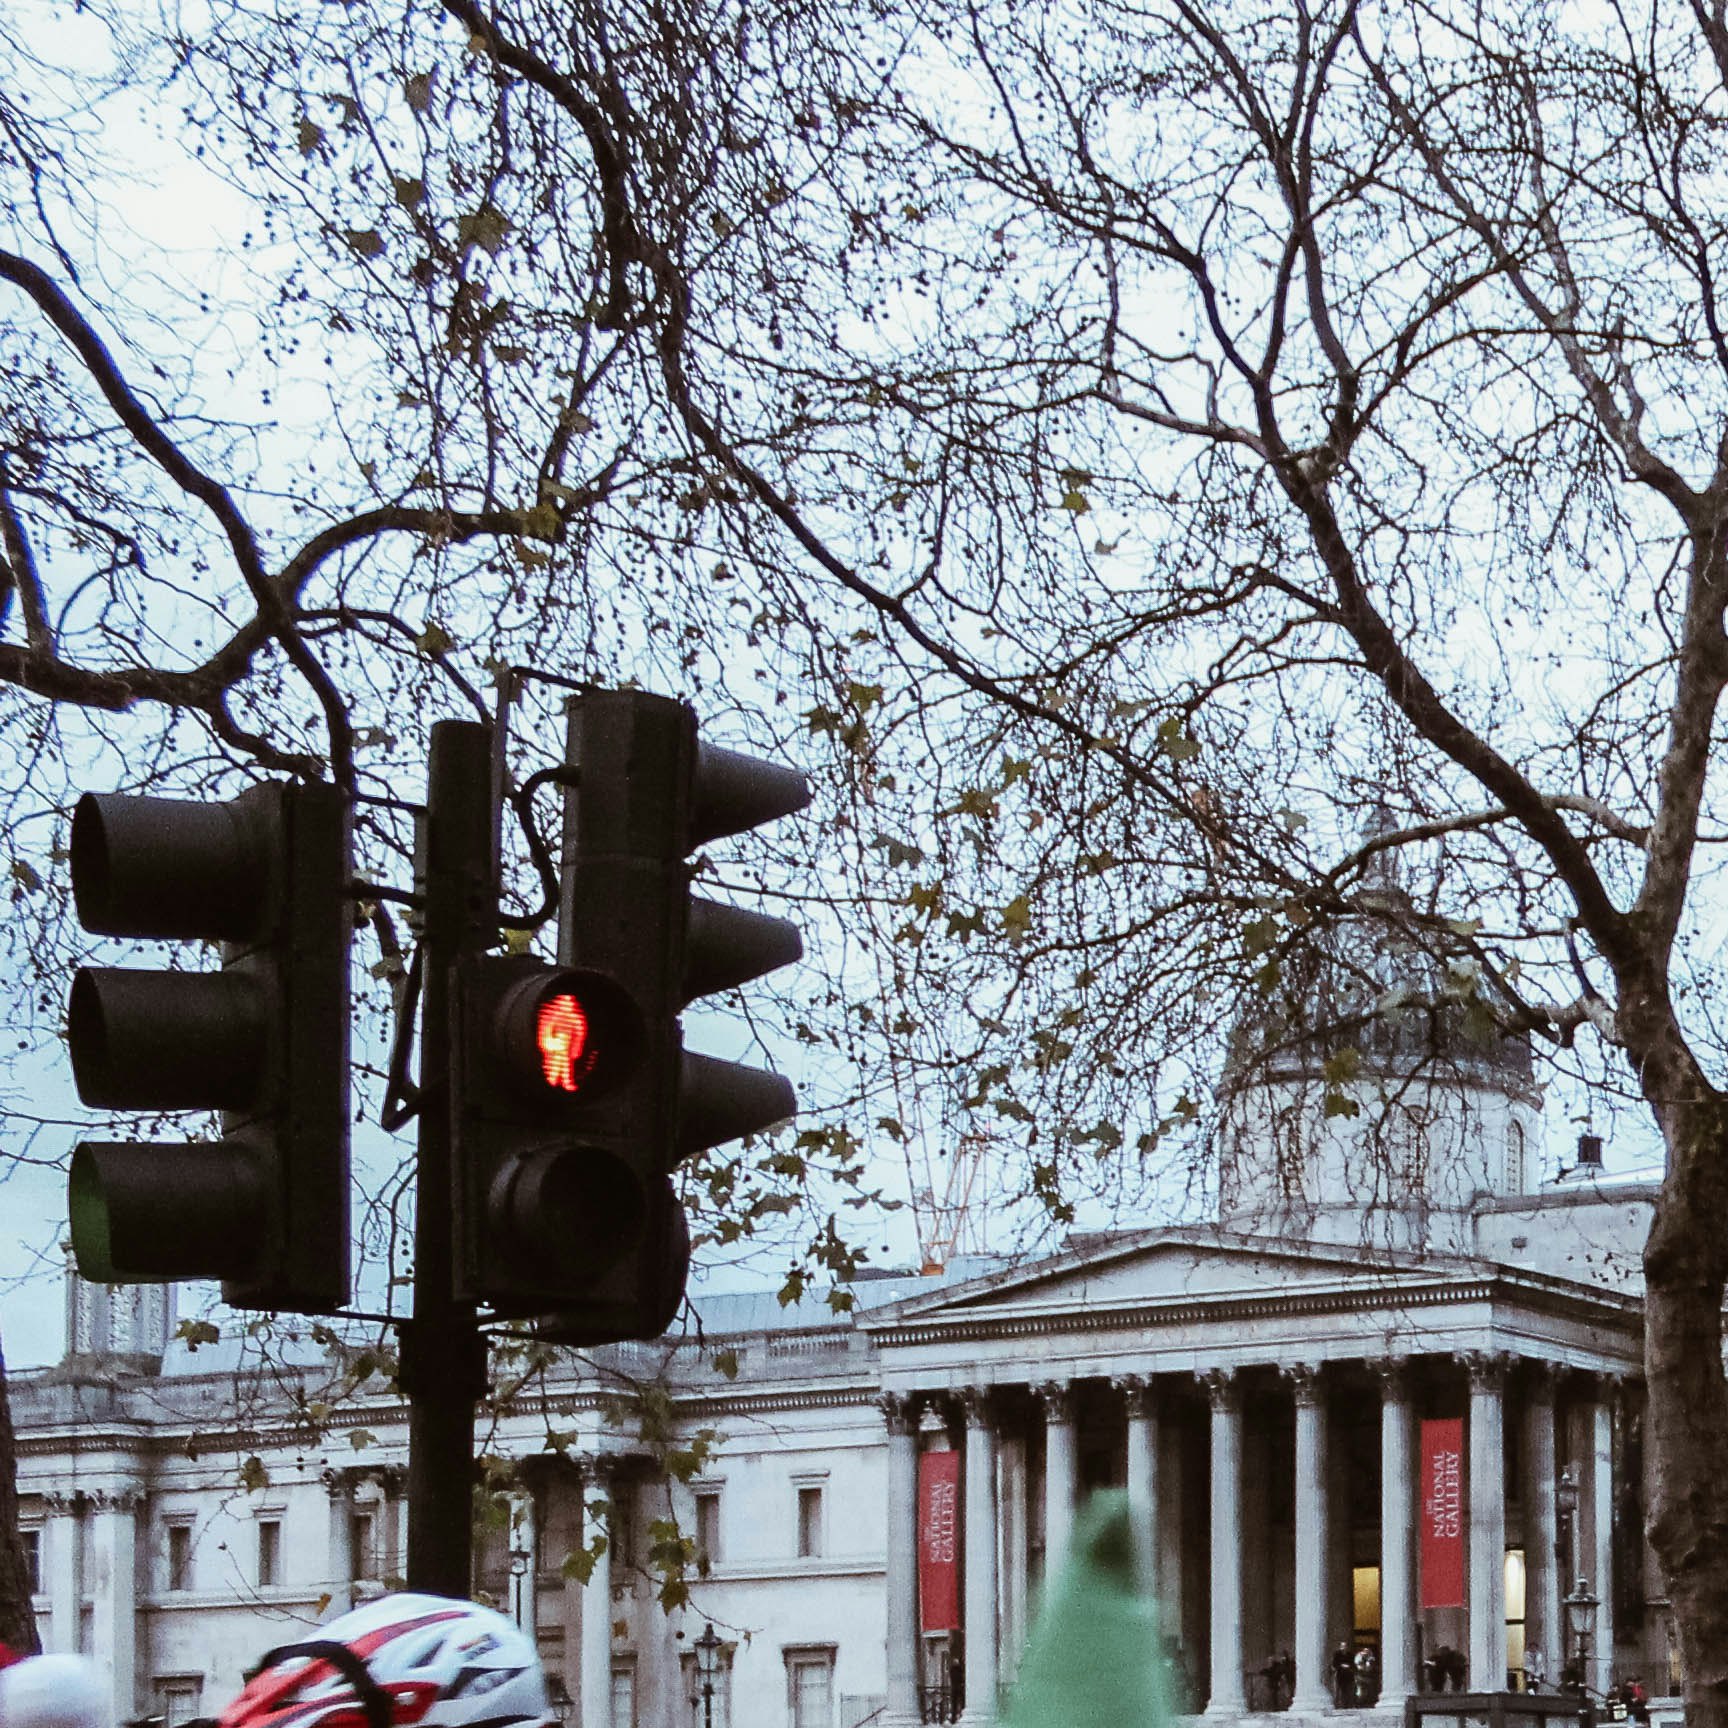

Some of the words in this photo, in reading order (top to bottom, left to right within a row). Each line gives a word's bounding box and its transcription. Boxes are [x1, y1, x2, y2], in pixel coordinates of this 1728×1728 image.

[930, 1483, 942, 1563] NATIONAL
[942, 1480, 954, 1563] GALLERY
[1433, 1450, 1445, 1538] NATIONAL
[1446, 1451, 1459, 1538] GALLERY
